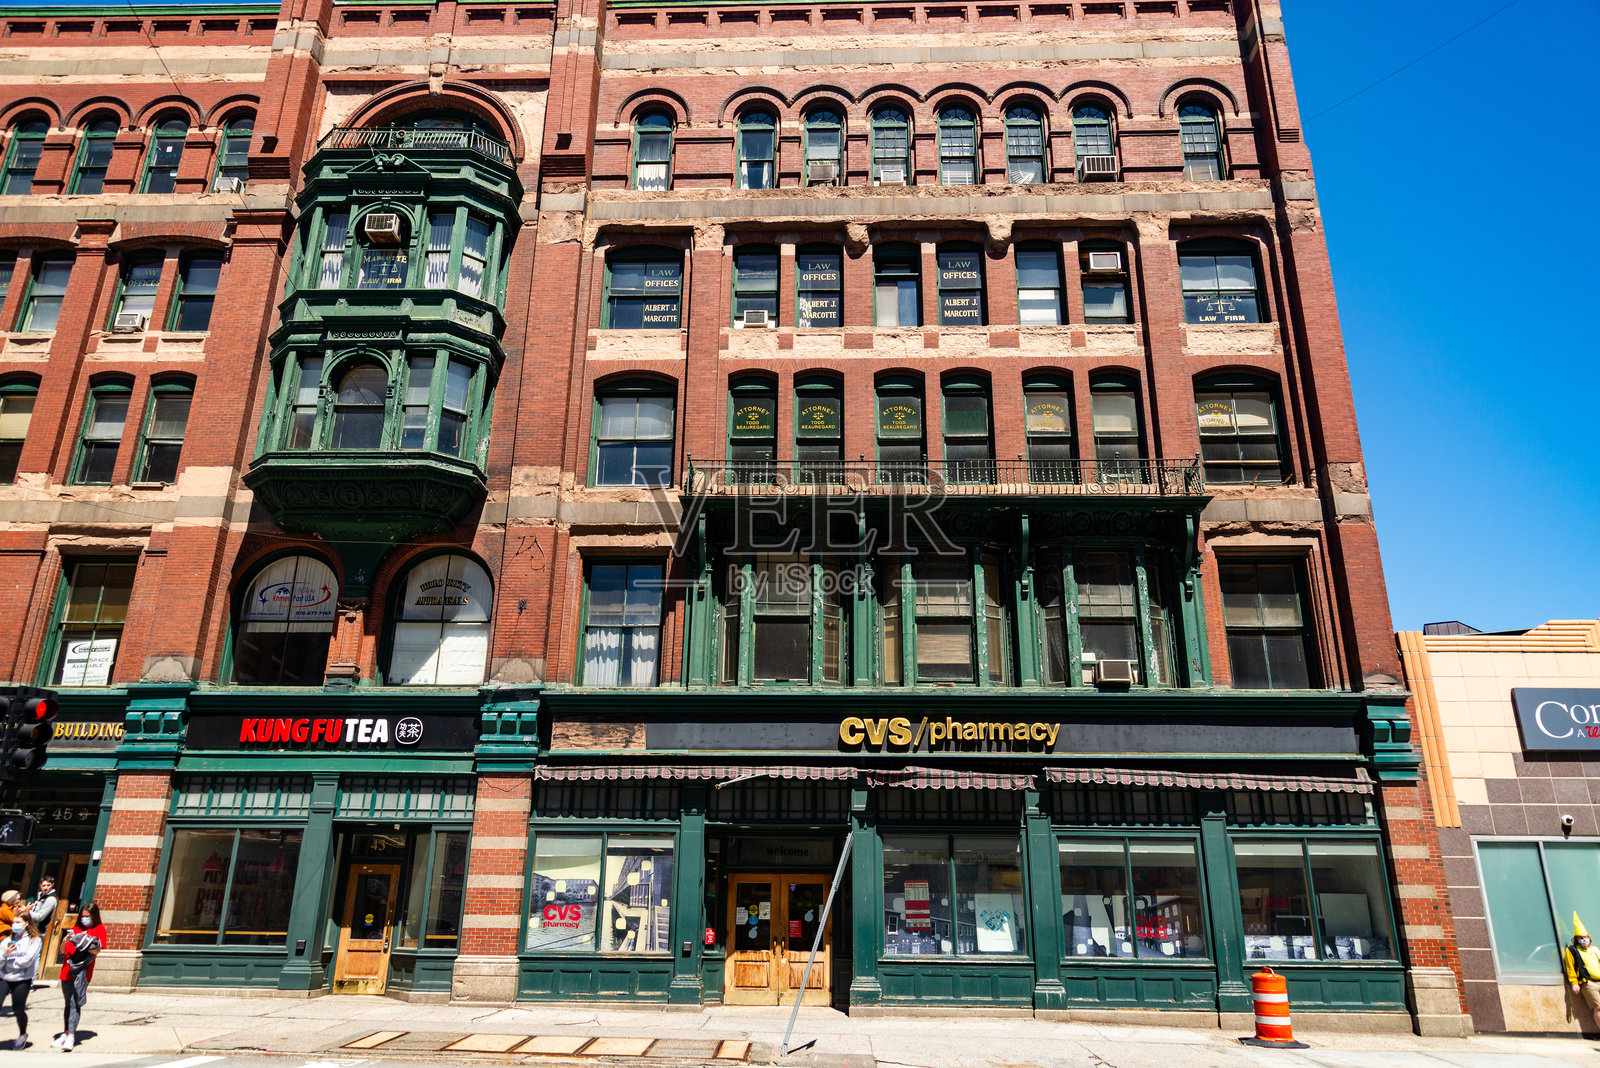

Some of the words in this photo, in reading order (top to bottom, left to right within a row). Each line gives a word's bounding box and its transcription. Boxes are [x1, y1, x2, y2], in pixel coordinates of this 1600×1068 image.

[363, 255, 408, 263] MARCOTTE
[802, 273, 837, 281] OFFICES
[943, 271, 977, 279] OFFICES
[736, 405, 771, 416] ATTORNEY
[801, 405, 835, 416] ATTORNEY
[882, 405, 917, 416] ATTORNEY
[1031, 404, 1064, 414] ATTORNEY
[1199, 403, 1232, 413] ATTORNEY
[419, 579, 471, 592] PRIORITY
[415, 596, 469, 606] APPRAISALS
[54, 722, 125, 738] BUILDING
[239, 718, 310, 743] KUNG
[310, 718, 343, 743] FU
[344, 718, 389, 743] TEA
[52, 807, 73, 820] 45
[371, 839, 386, 850] 43
[766, 845, 809, 856] welcome
[543, 904, 582, 921] CVS
[543, 921, 580, 929] pharmacy
